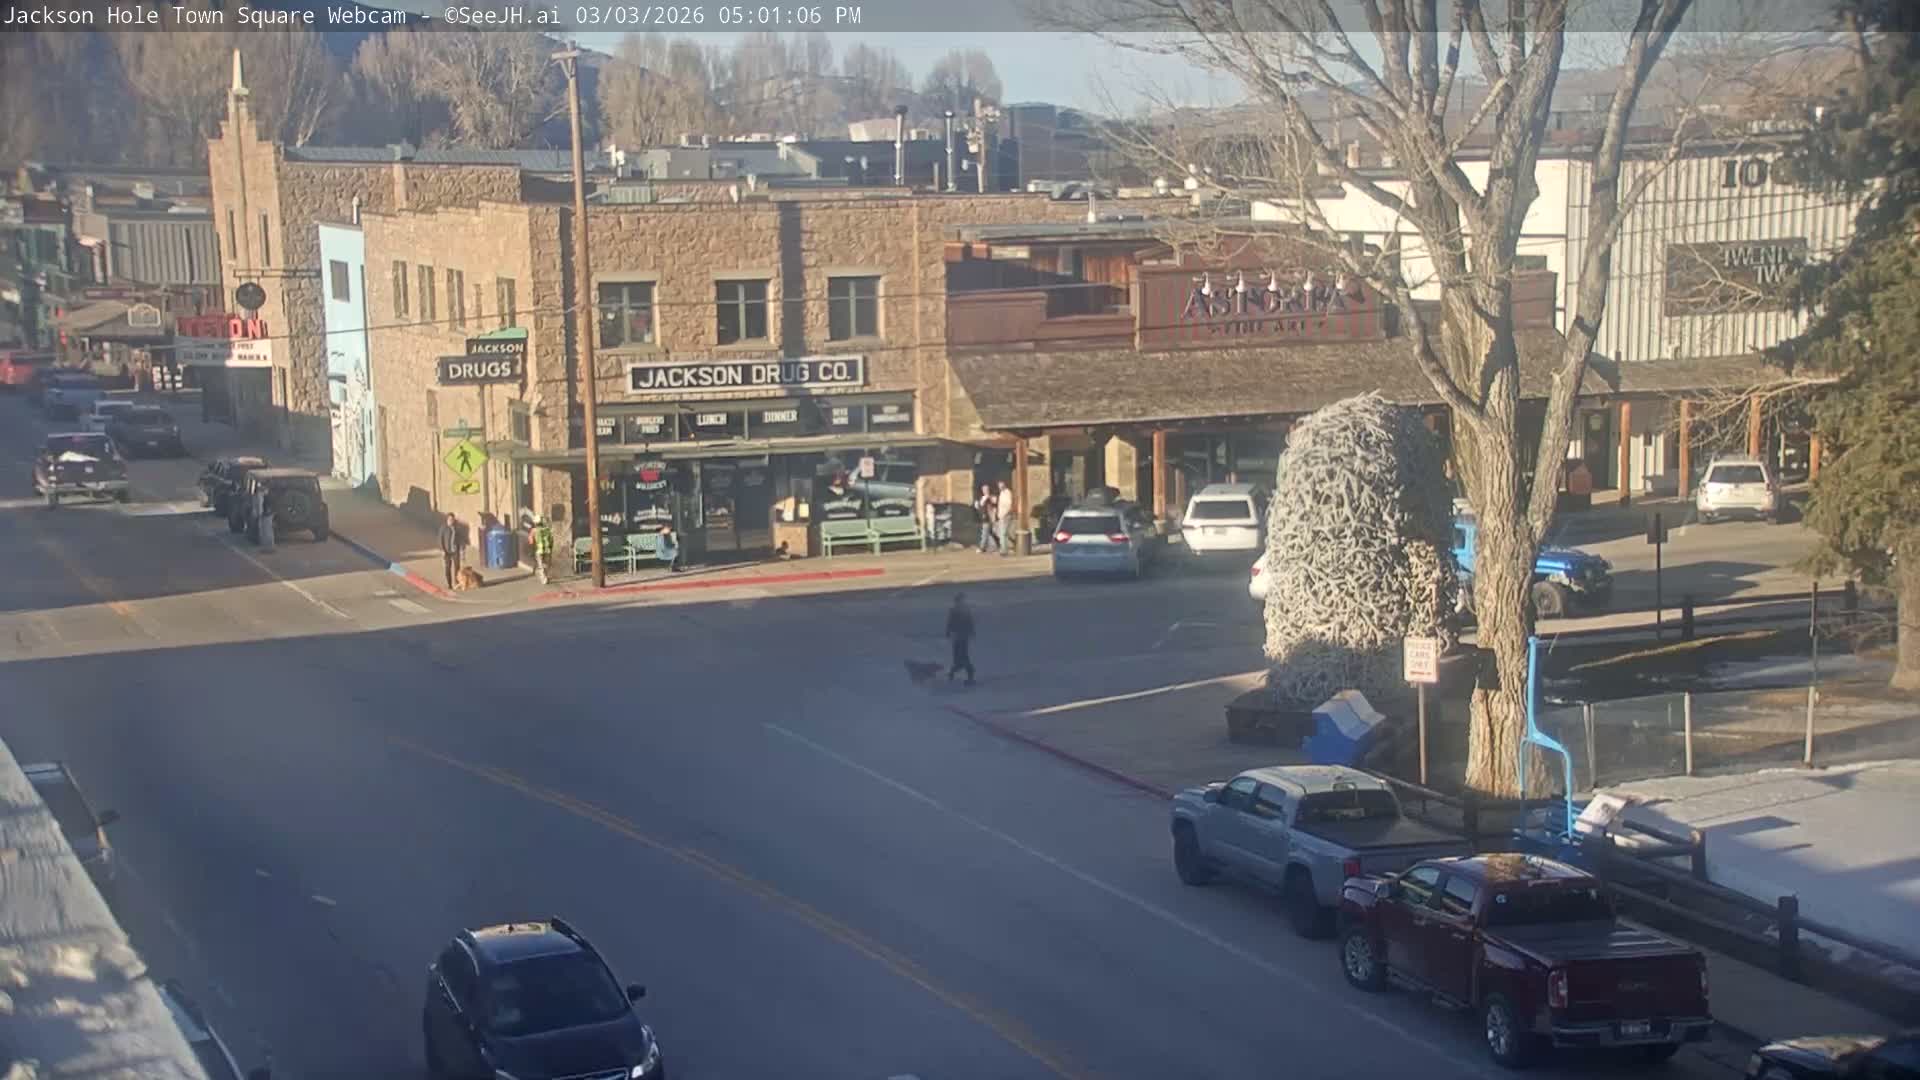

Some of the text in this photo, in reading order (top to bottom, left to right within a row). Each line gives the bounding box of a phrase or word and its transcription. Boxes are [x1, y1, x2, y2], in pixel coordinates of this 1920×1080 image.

[471, 343, 524, 354] JACKSON
[449, 361, 511, 379] DRUGS
[639, 361, 852, 388] JACKSON DRUG CO.
[697, 413, 728, 425] LUNCH
[763, 410, 798, 423] DINNER
